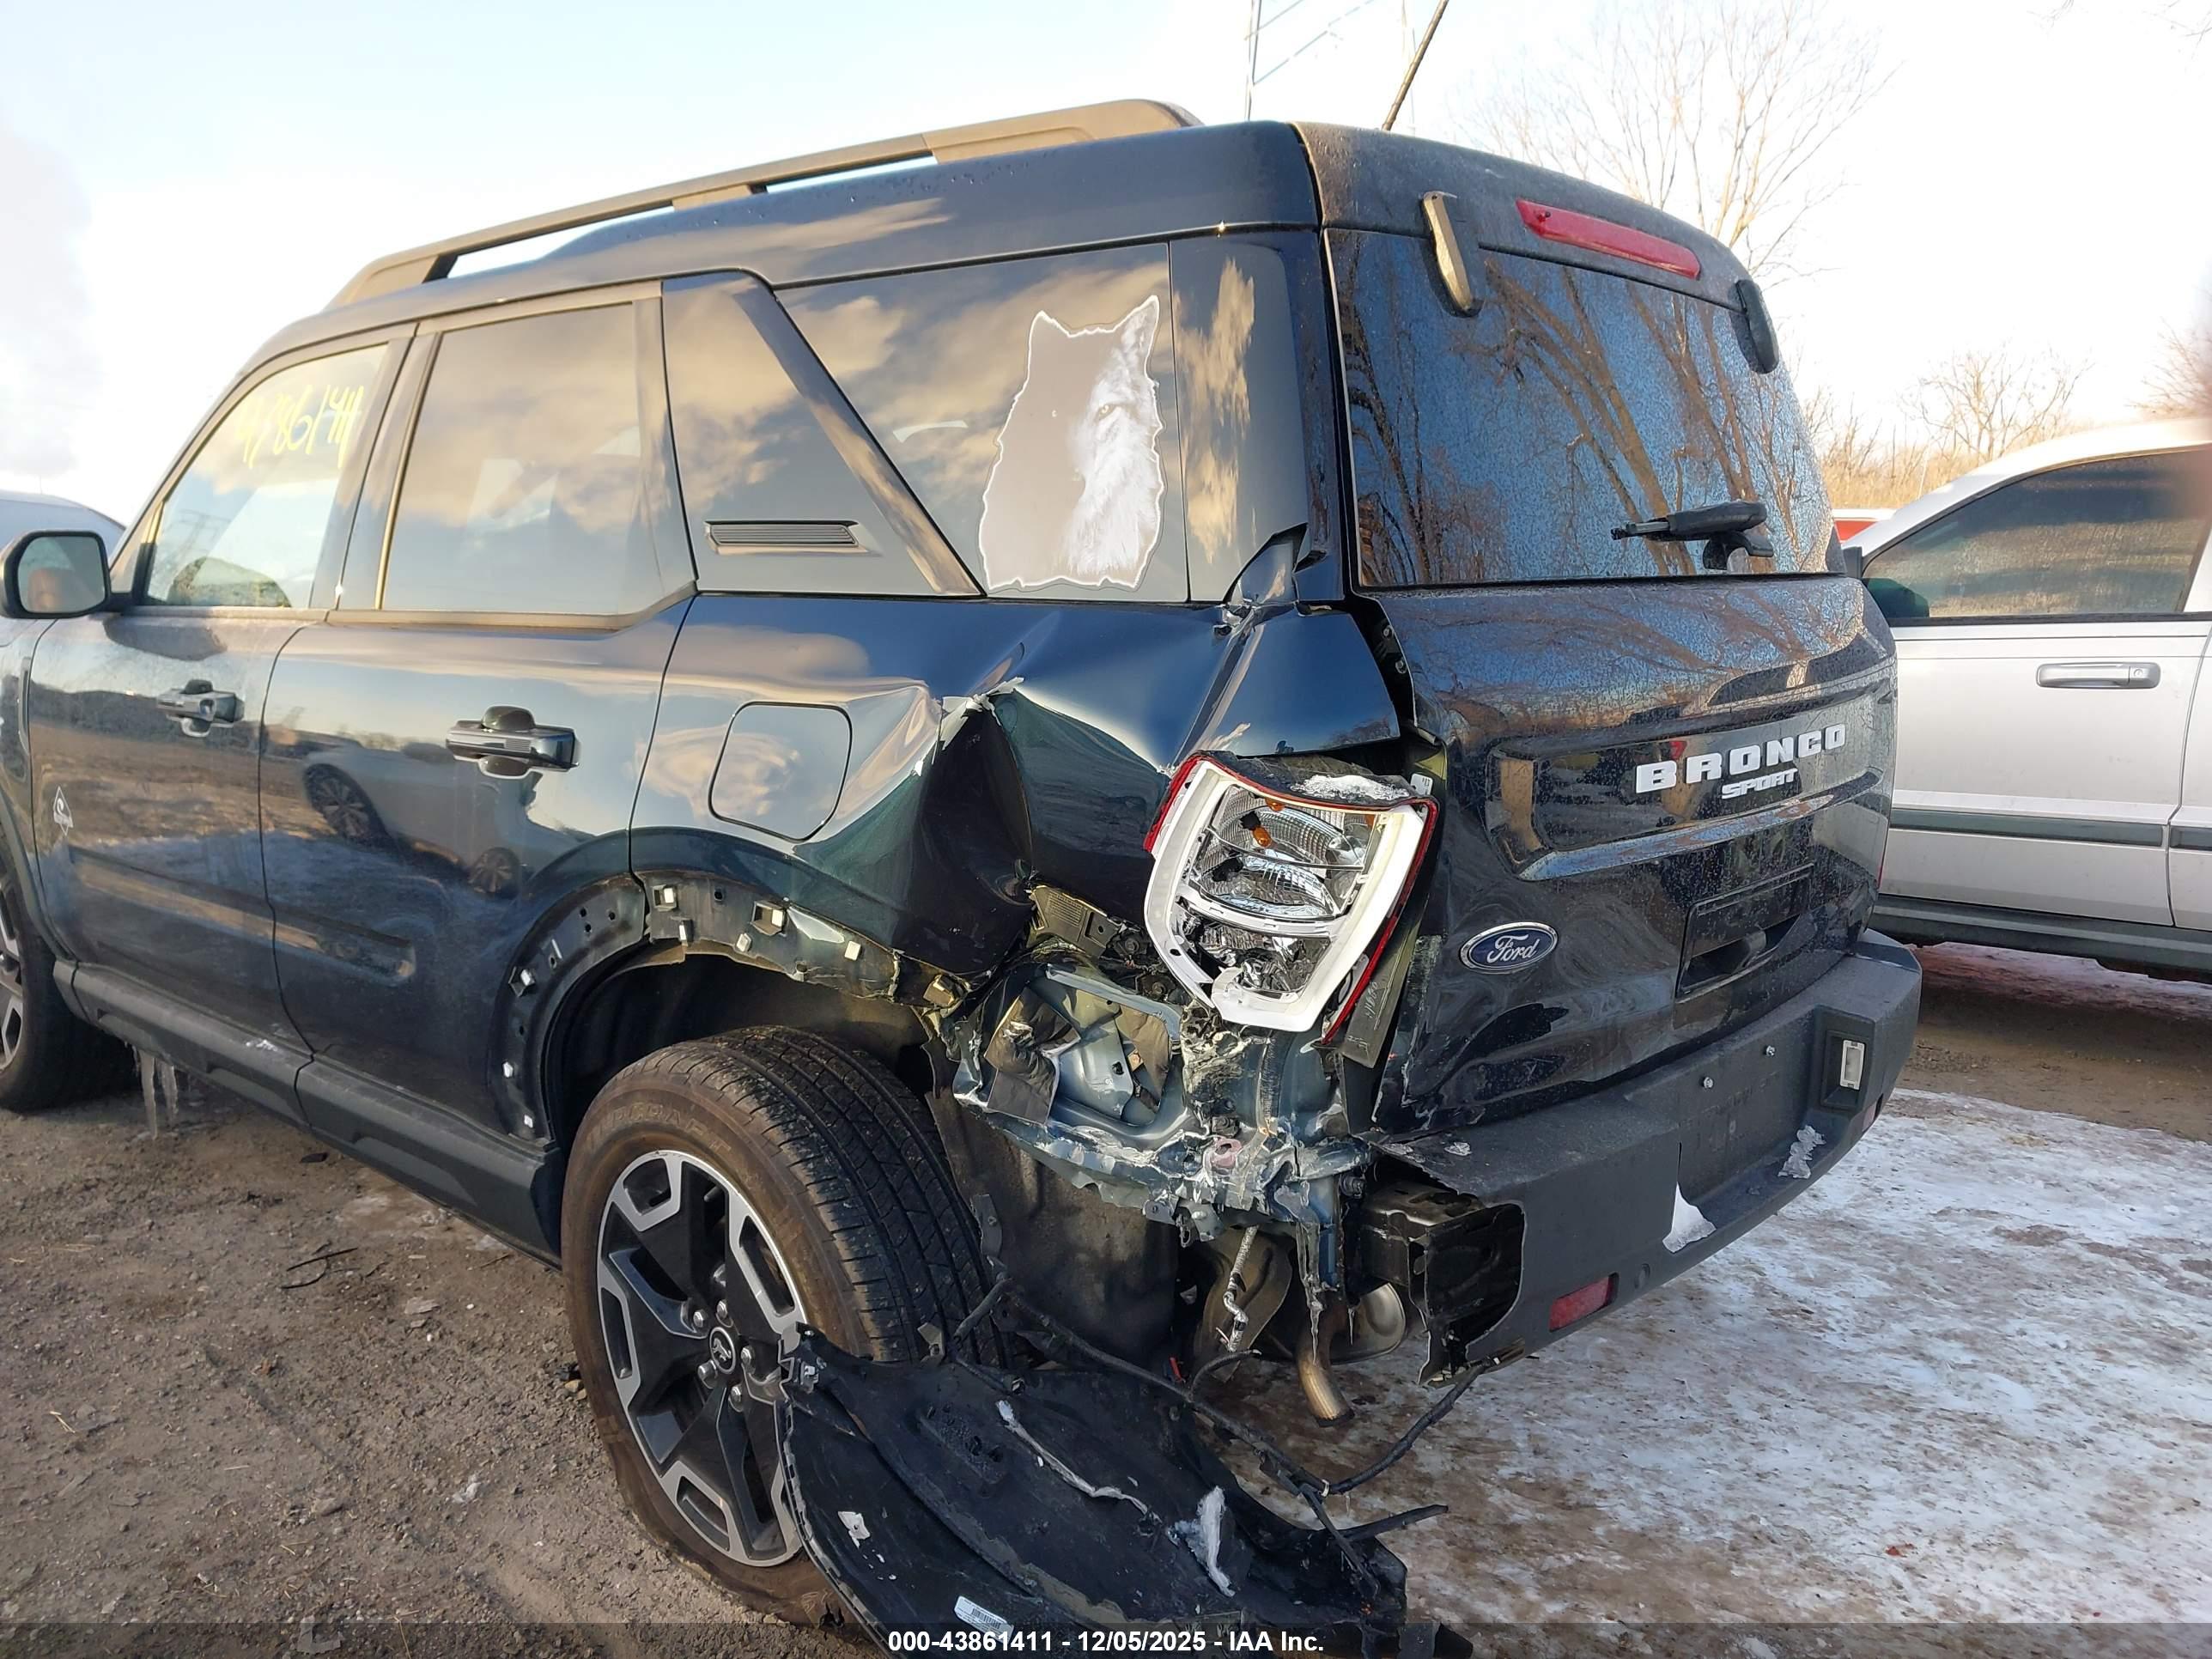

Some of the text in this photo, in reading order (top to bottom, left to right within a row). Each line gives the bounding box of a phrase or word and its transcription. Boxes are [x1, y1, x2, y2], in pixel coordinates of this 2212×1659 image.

[1636, 723, 1846, 794] BRONCO
[1721, 768, 1798, 799] SPORT
[1486, 933, 1540, 963] Ford
